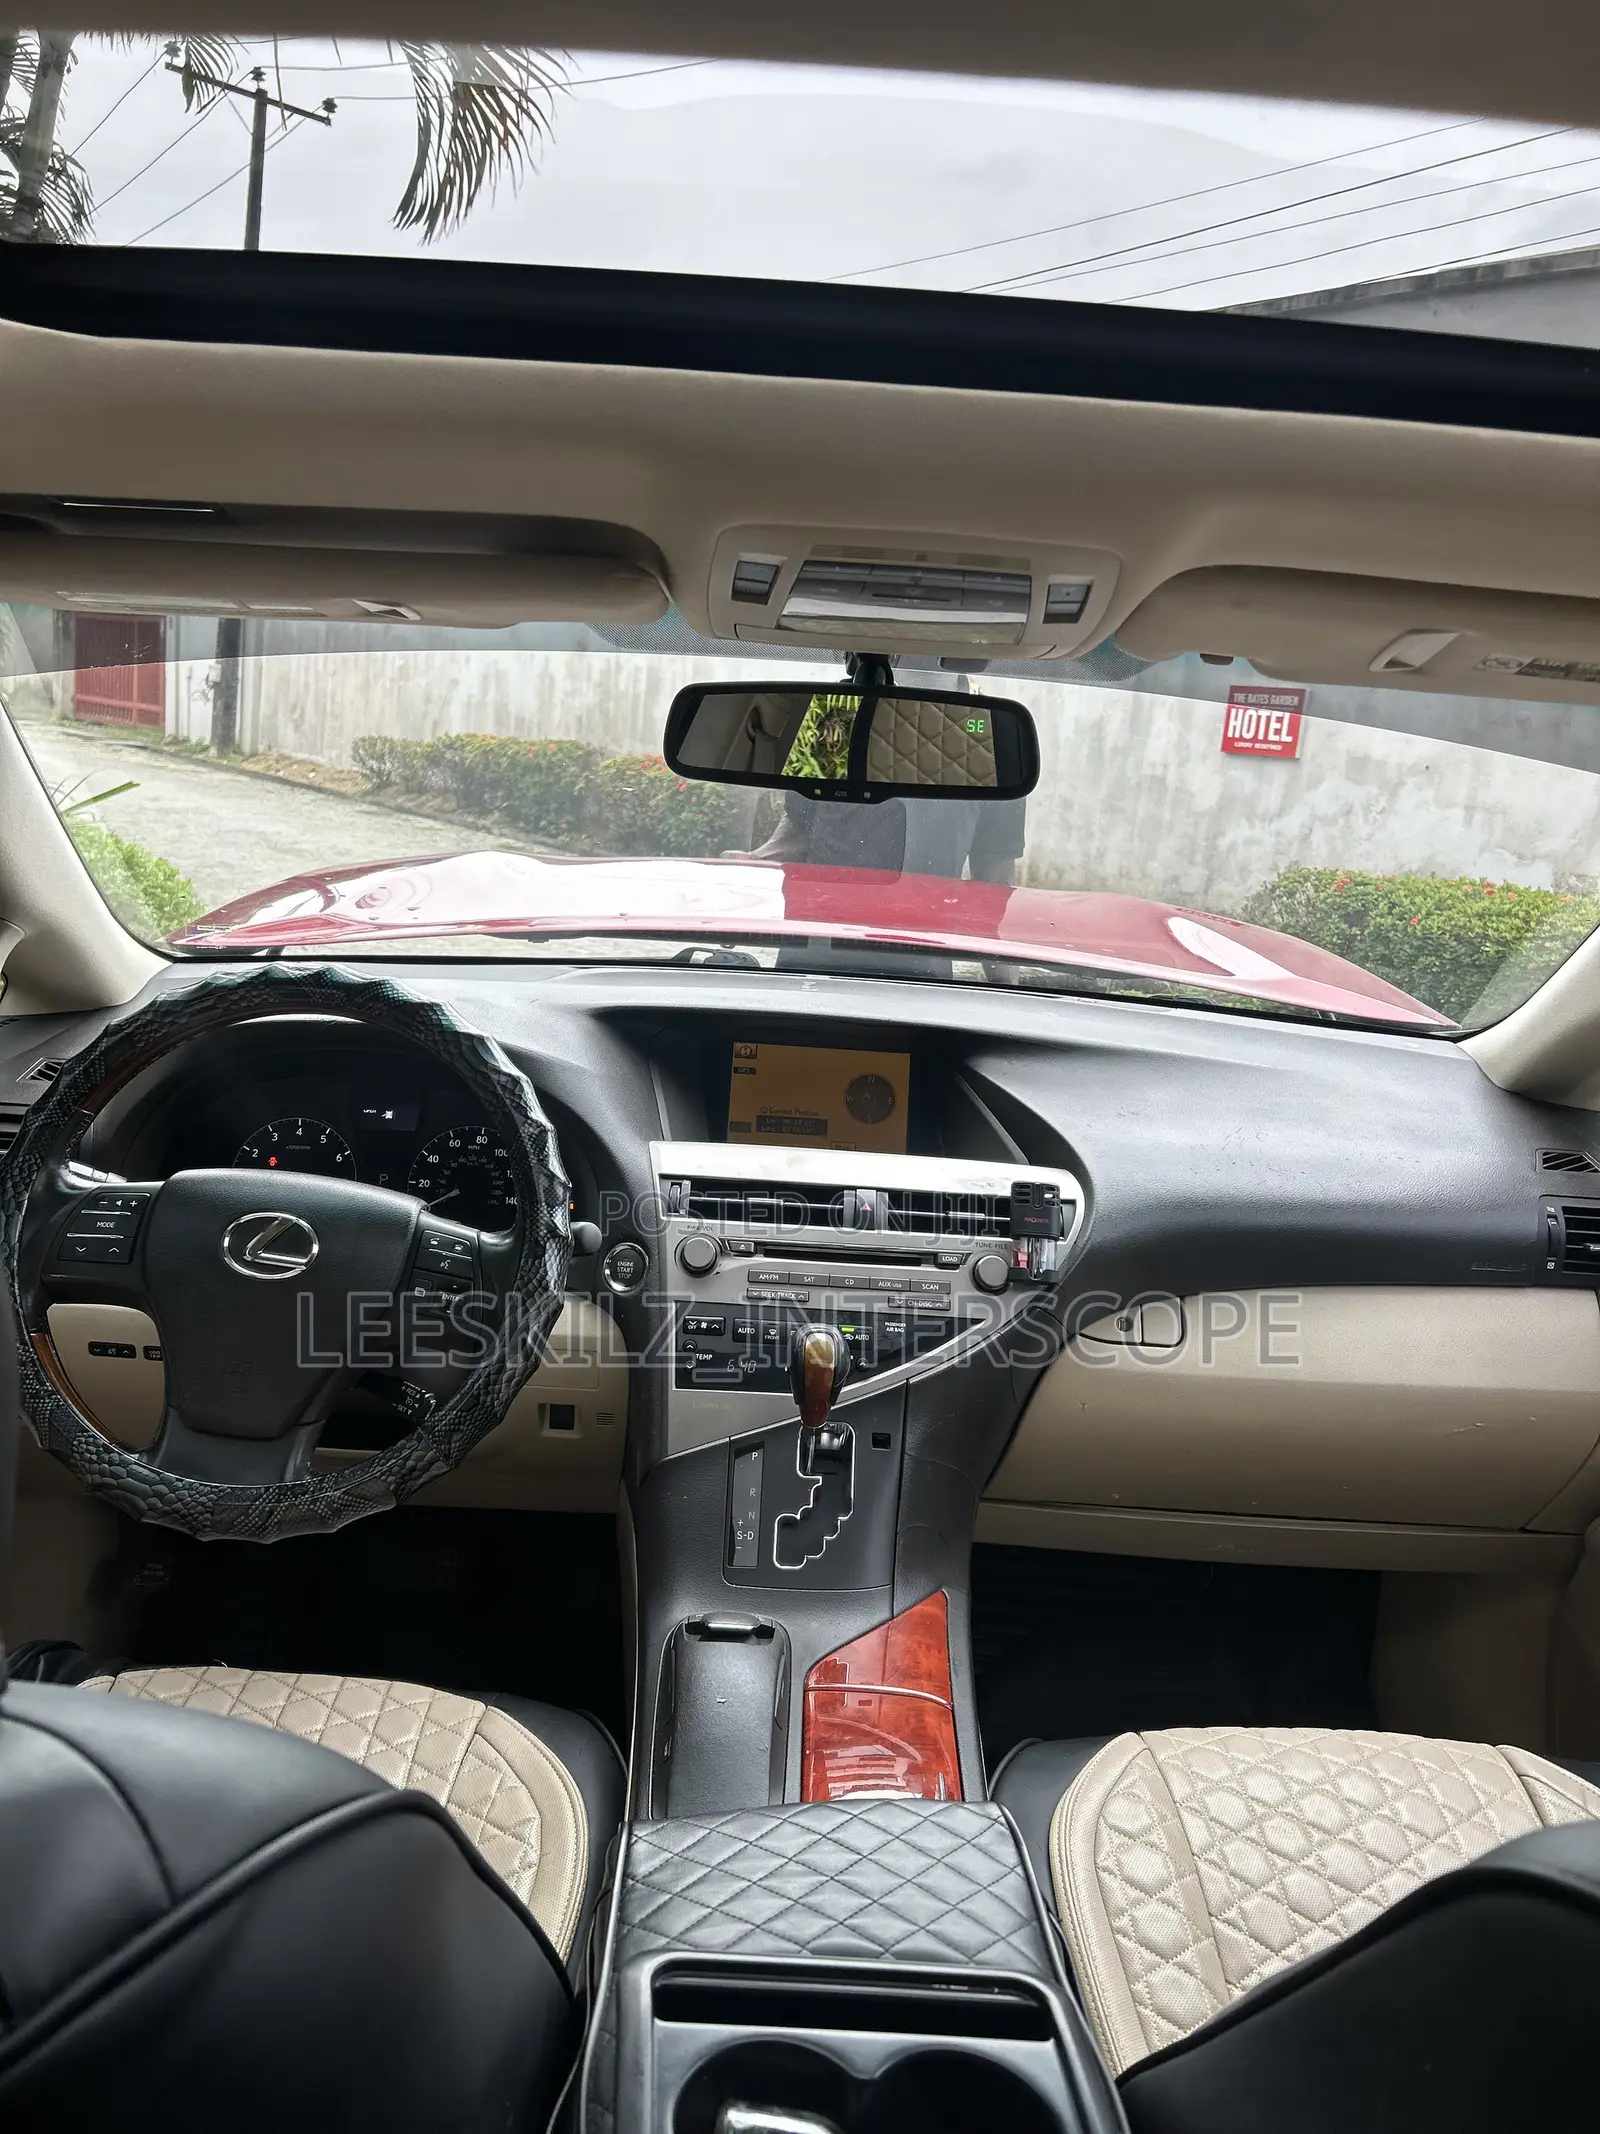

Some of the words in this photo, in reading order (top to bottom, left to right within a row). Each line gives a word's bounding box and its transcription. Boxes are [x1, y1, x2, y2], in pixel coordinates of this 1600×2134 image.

[966, 719, 985, 733] SE
[1227, 708, 1293, 743] HOTEL
[296, 1128, 302, 1136] 4
[272, 1133, 278, 1141] 3
[320, 1135, 327, 1144] 5
[476, 1136, 488, 1144] 80
[449, 1139, 461, 1147] 60
[252, 1149, 258, 1157] 2
[336, 1154, 342, 1162] 6
[427, 1155, 439, 1163] 40
[379, 1174, 389, 1185] P
[751, 1452, 759, 1460] P
[749, 1488, 756, 1496] R
